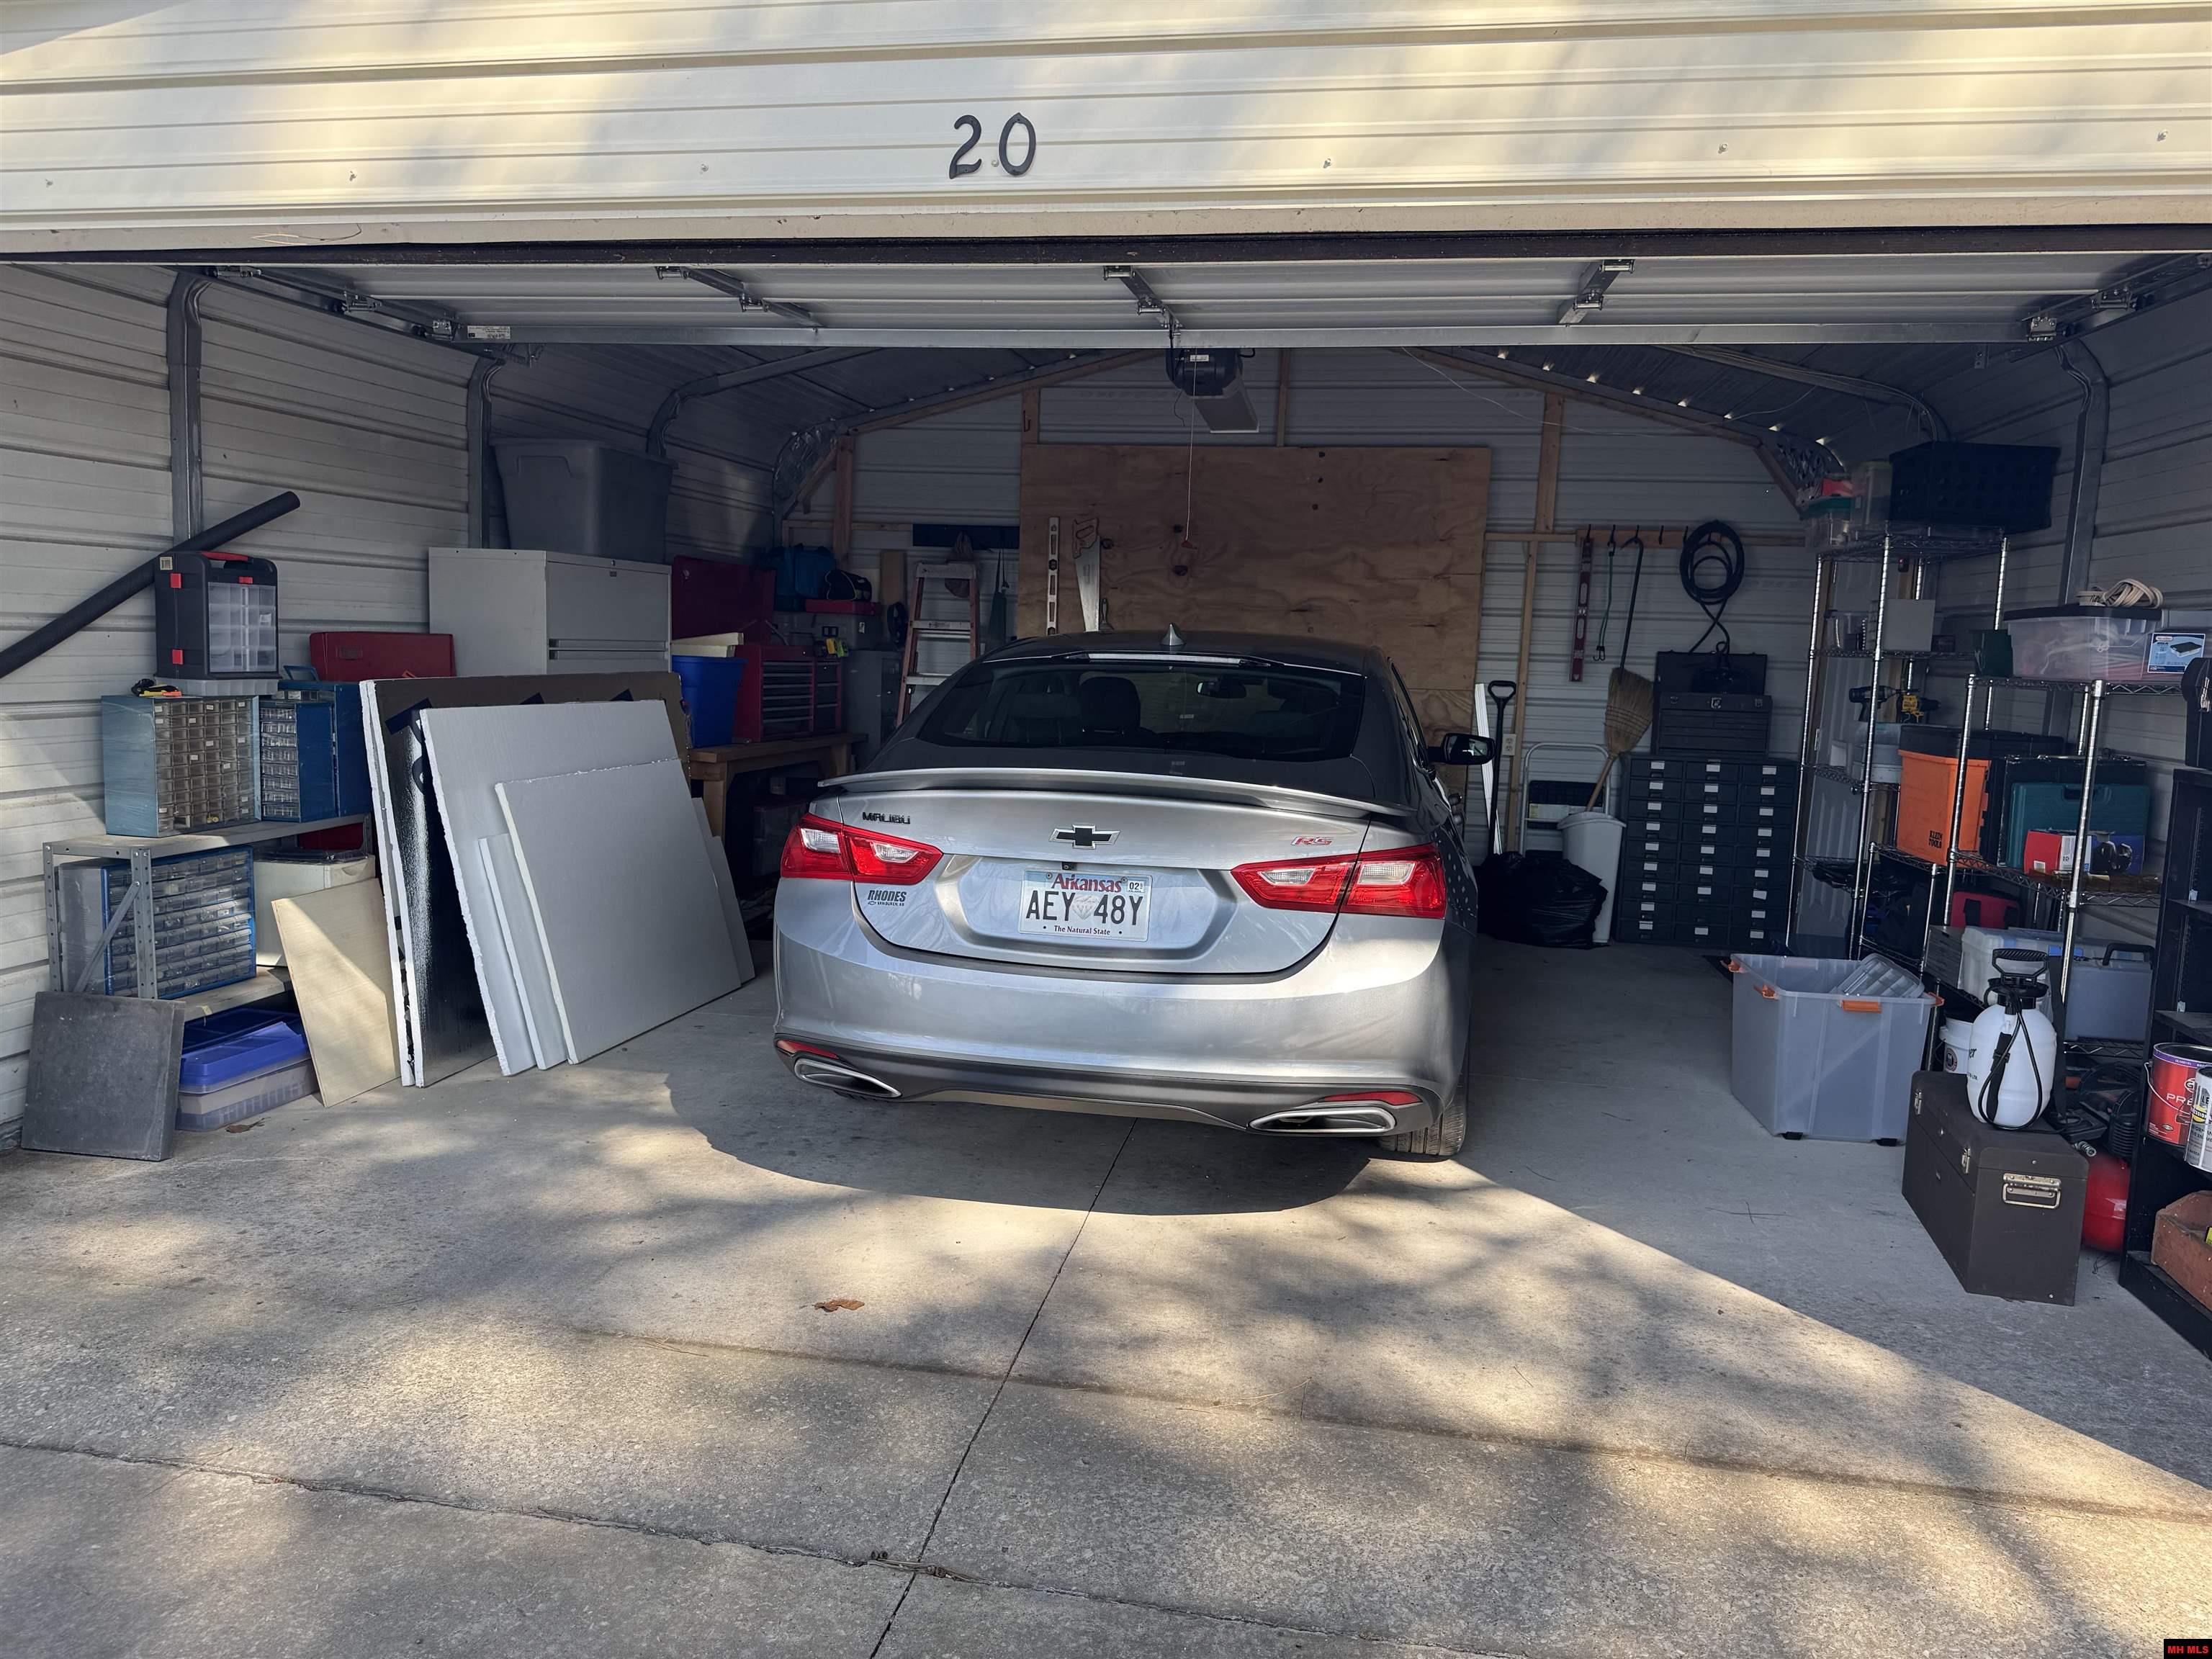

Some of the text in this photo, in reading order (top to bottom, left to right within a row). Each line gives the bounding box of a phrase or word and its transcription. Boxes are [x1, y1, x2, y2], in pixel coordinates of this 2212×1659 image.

[949, 112, 1036, 179] 20
[862, 811, 911, 824] MALIBU
[1291, 836, 1332, 846] RS
[1051, 873, 1123, 893] Arkansas
[868, 890, 907, 902] RHODES
[1026, 890, 1143, 926] AEY 48Y
[1067, 926, 1092, 935] Natural
